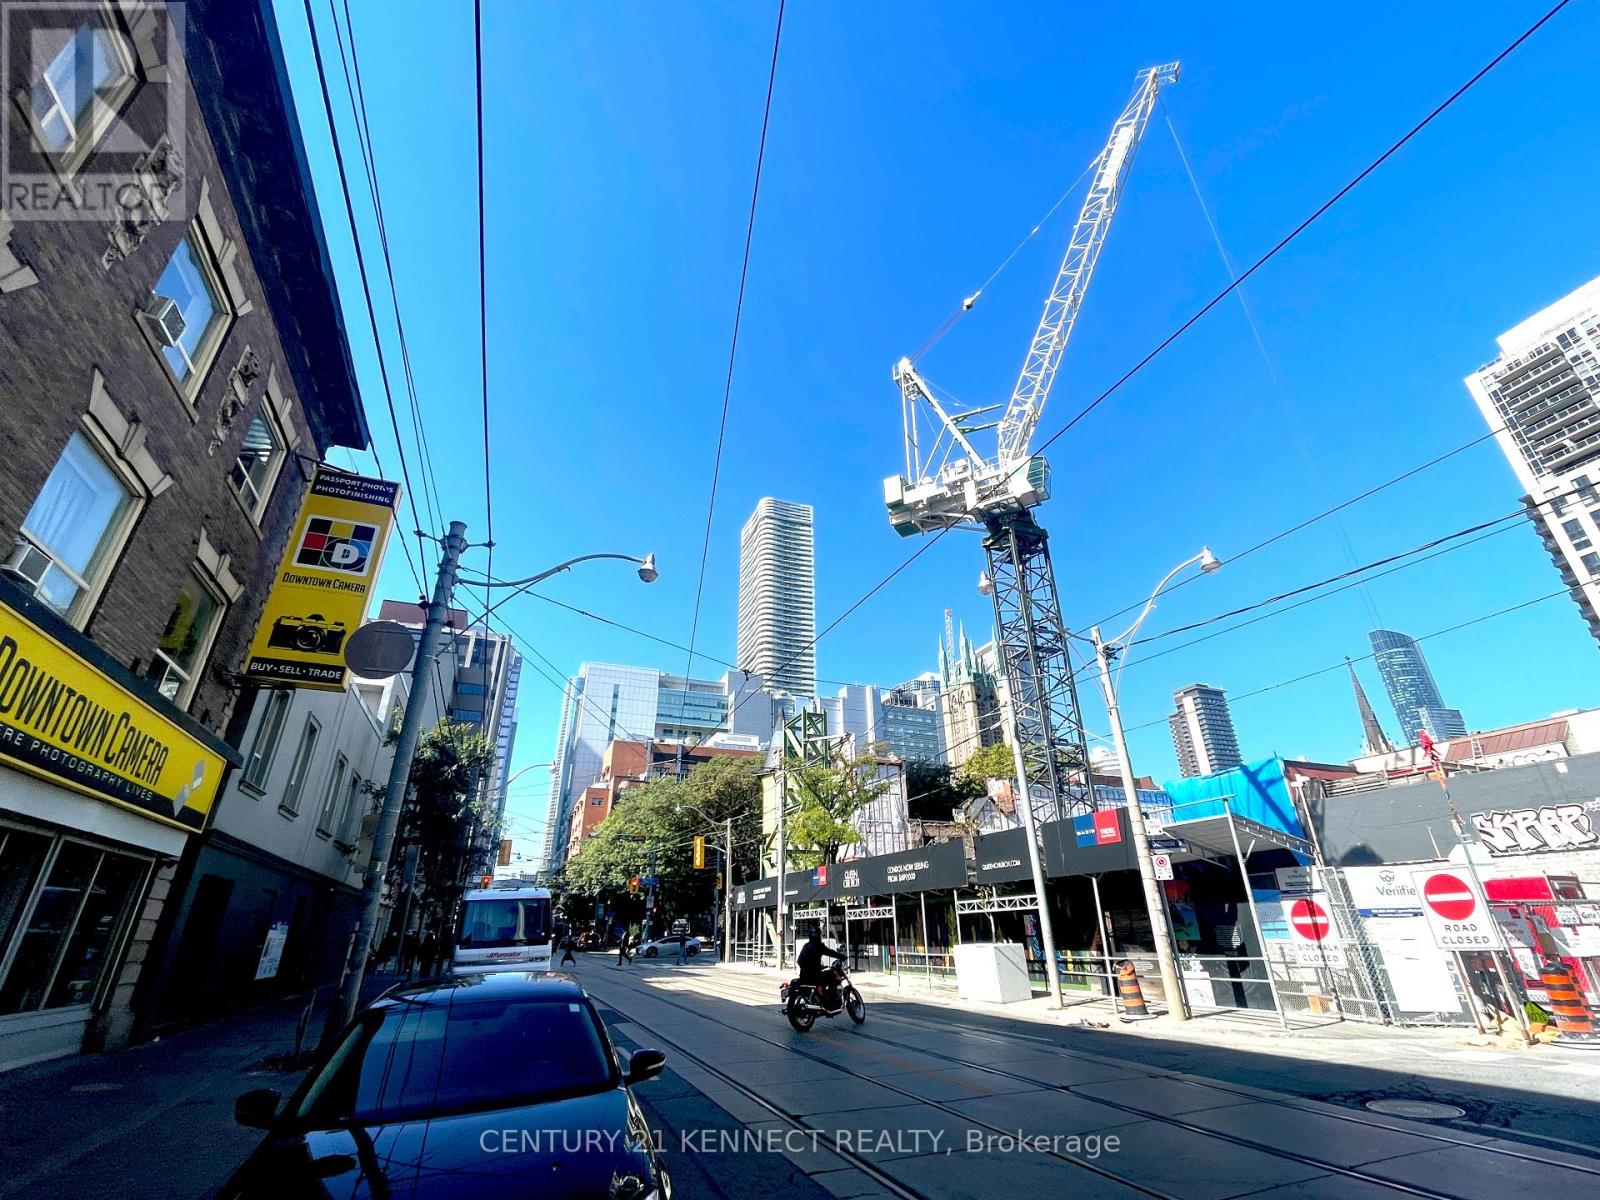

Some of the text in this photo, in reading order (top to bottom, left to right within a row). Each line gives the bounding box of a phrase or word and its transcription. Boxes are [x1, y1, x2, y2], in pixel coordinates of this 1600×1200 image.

[319, 474, 361, 487] PASSPORT
[315, 485, 390, 504] PHOTOFINISHING
[250, 662, 342, 679] BUY SELL TRADE
[30, 739, 124, 788] PHOTOGRAPHY
[125, 783, 154, 801] LIVES
[1444, 923, 1478, 932] ROAD
[1442, 935, 1490, 944] CLOSED
[1303, 954, 1340, 962] CLOSED
